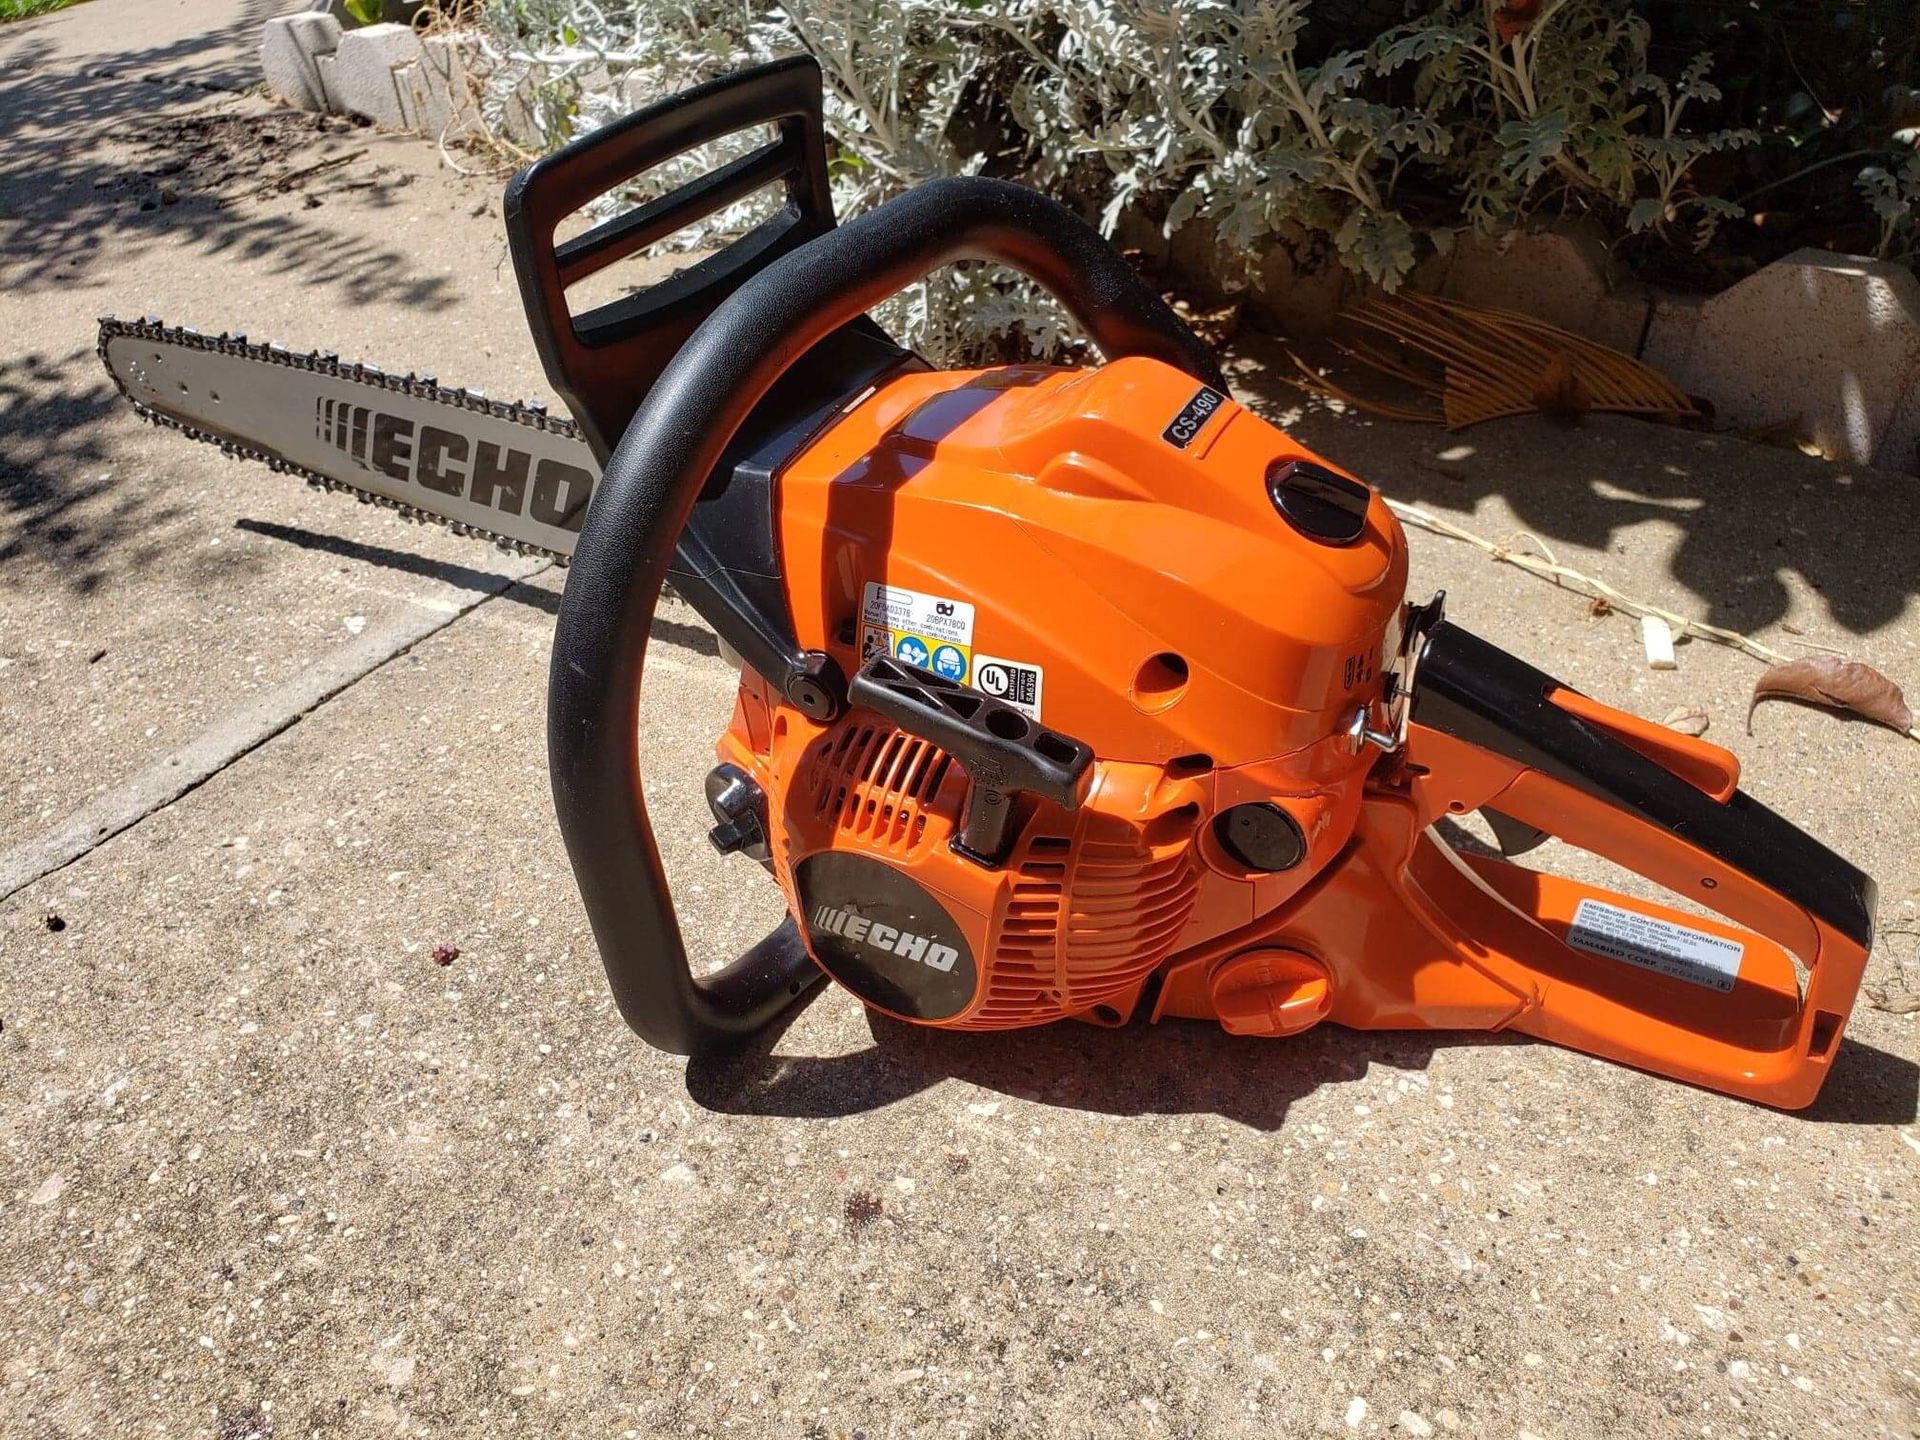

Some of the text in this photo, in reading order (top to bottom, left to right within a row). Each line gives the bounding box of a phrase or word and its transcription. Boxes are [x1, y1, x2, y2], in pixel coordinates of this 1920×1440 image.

[1172, 393, 1218, 440] CS-490
[371, 412, 595, 534] ECHO
[986, 669, 1003, 692] UL
[1009, 668, 1017, 700] CERTIFIED
[1026, 673, 1036, 703] SA6396
[842, 914, 959, 973] ECHO
[1572, 936, 1625, 957] YAMABIKO
[1583, 902, 1626, 919] EMISSION
[1630, 916, 1672, 933] CONTROL
[1677, 929, 1741, 953] INFORMATION
